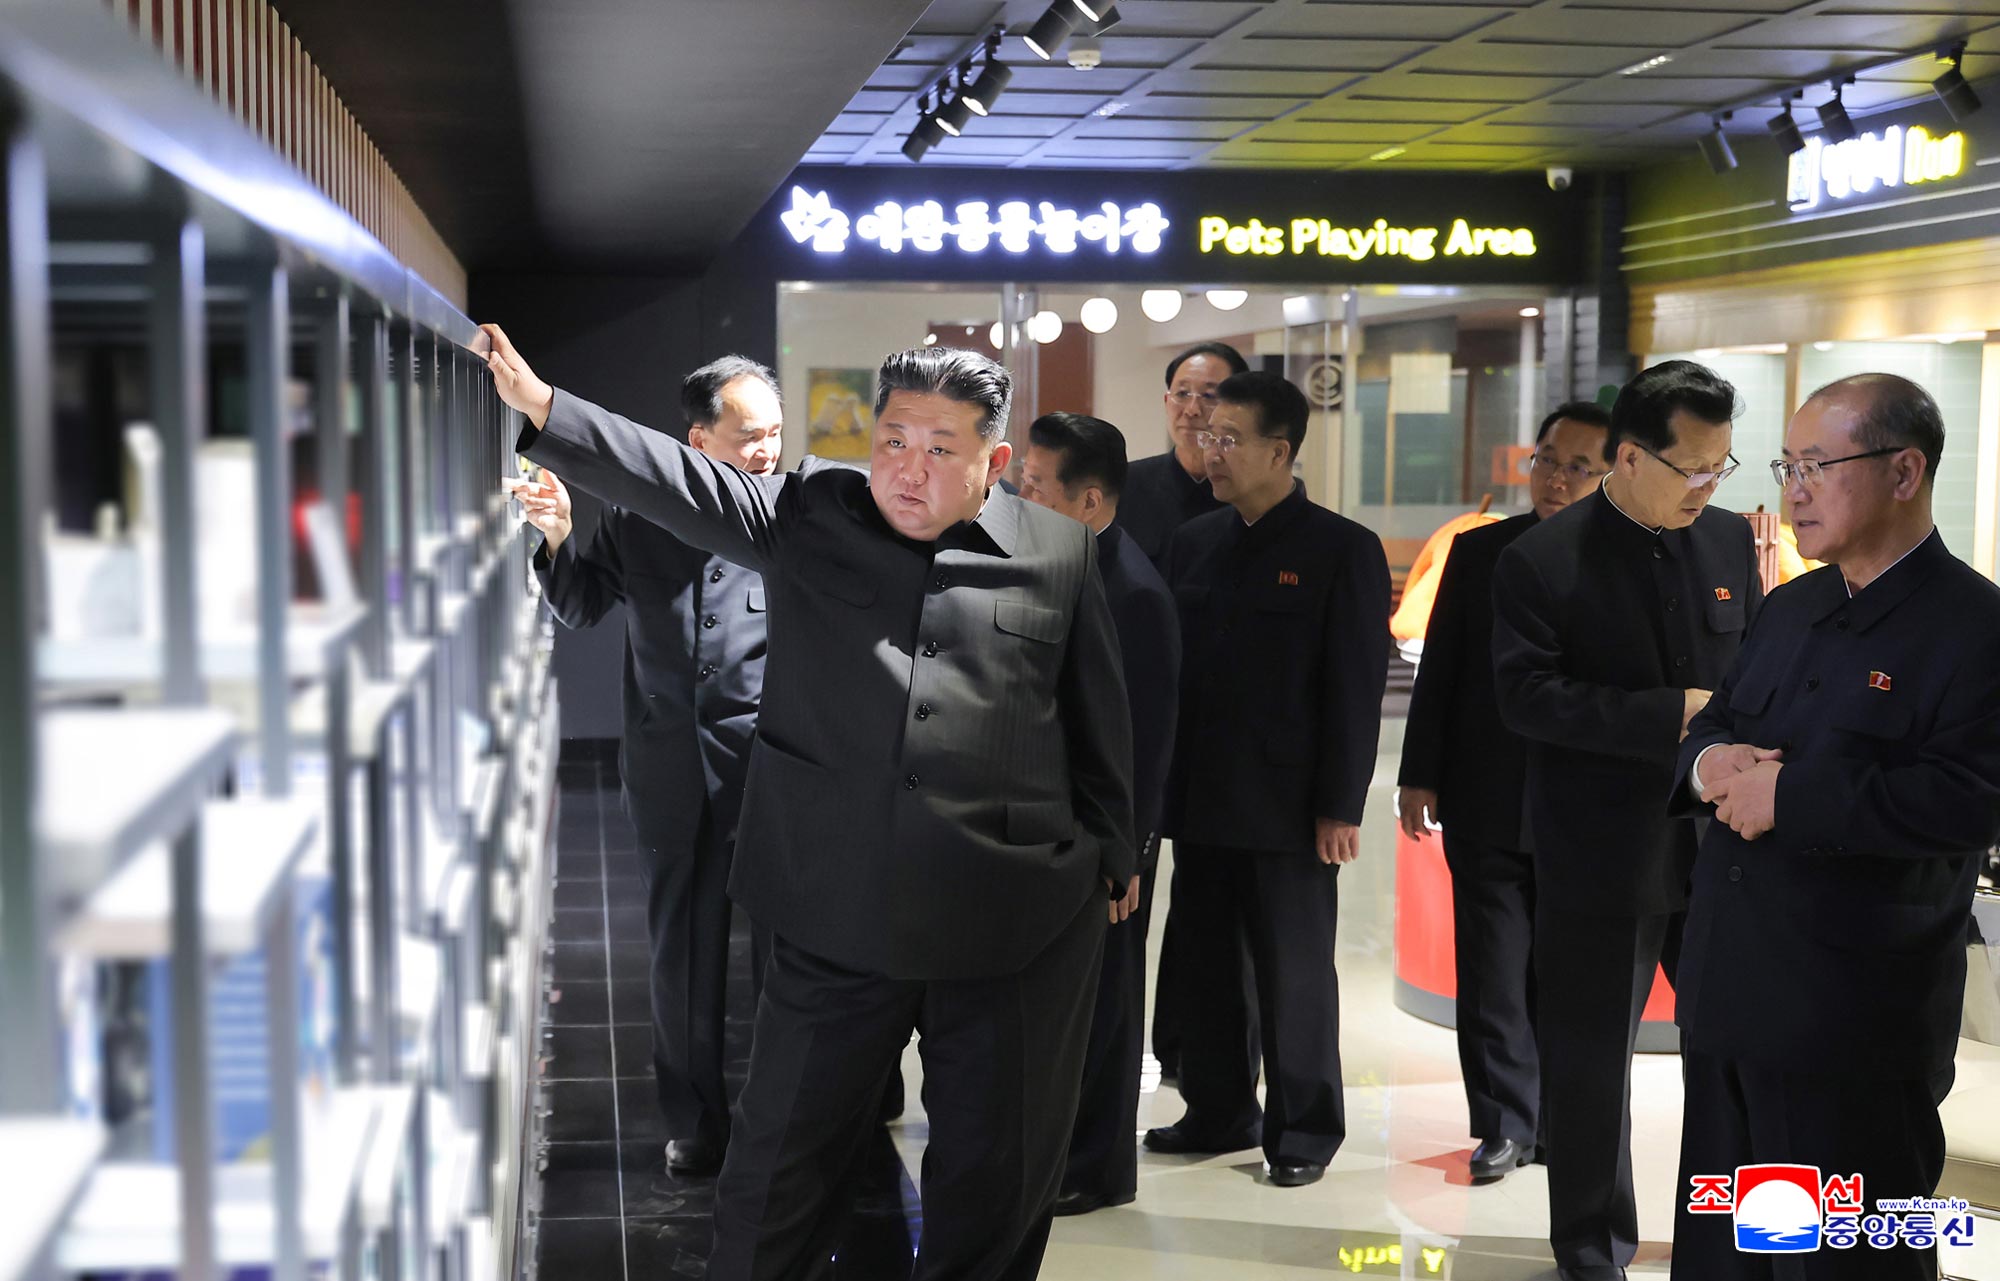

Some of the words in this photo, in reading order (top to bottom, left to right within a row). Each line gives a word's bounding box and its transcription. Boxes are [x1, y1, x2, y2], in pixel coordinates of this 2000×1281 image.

[1200, 217, 1284, 255] Pets
[1291, 218, 1438, 261] Playing
[1443, 218, 1537, 256] Area
